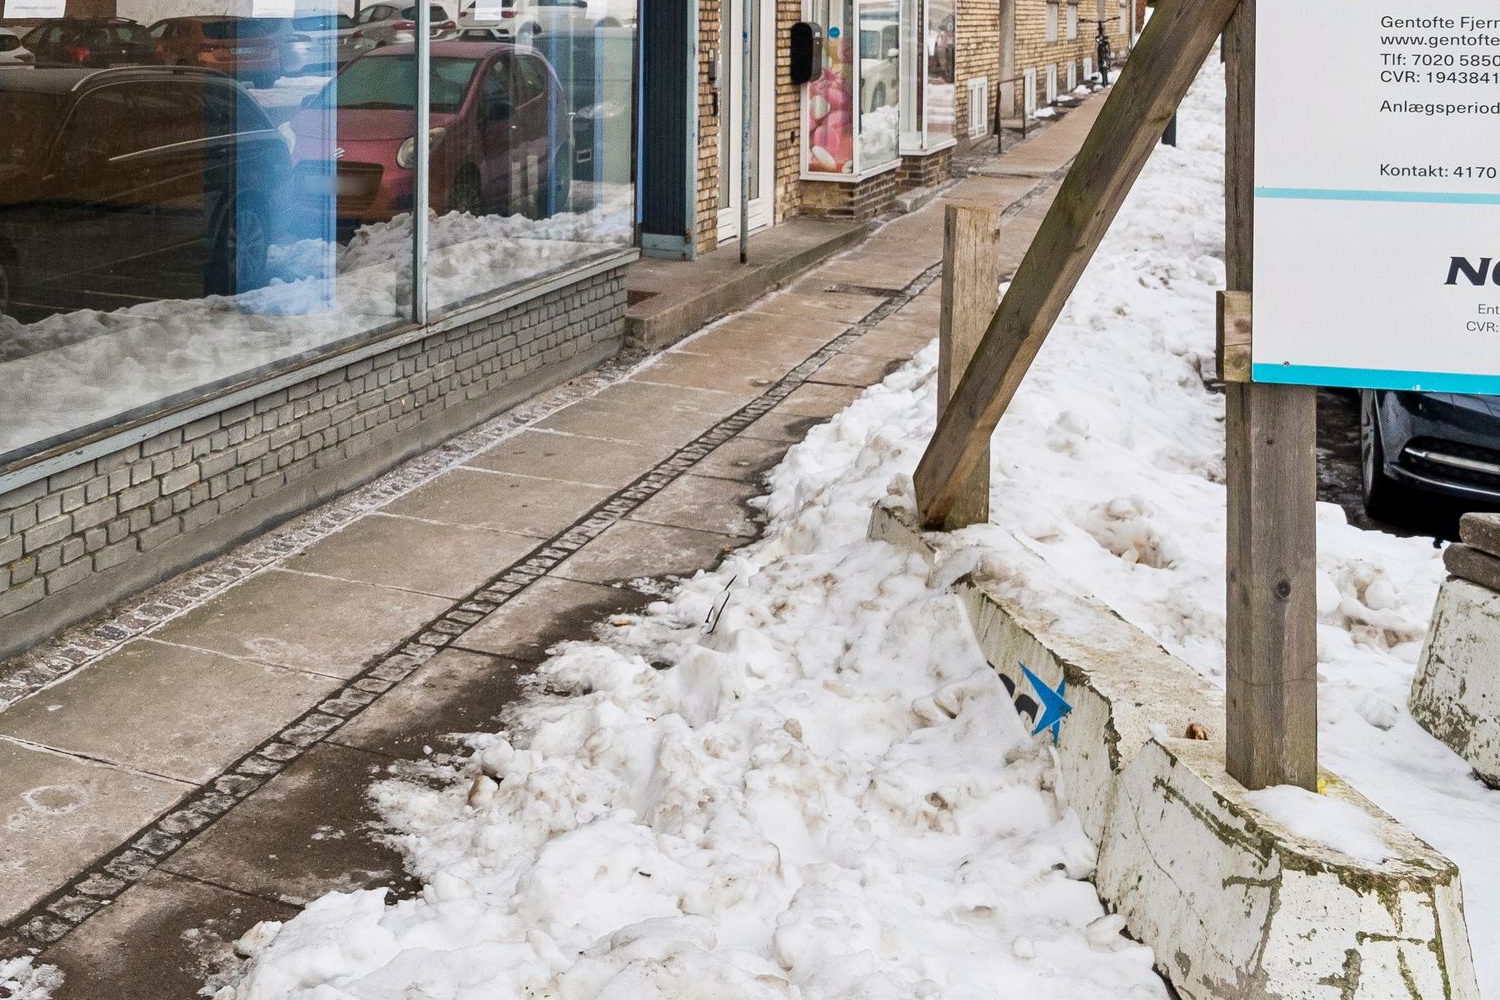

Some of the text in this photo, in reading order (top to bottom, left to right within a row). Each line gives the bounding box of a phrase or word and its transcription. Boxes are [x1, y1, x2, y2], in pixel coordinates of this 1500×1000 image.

[1380, 15, 1455, 29] Gentofte
[1380, 34, 1500, 49] www.gentofte
[1380, 53, 1500, 67] Tlf: 7020 5850
[1380, 70, 1499, 84] CVR: 1943841
[1380, 100, 1500, 116] Anlægsperiod
[1380, 163, 1497, 179] Kontakt: 4170
[1466, 320, 1499, 333] CVR:
